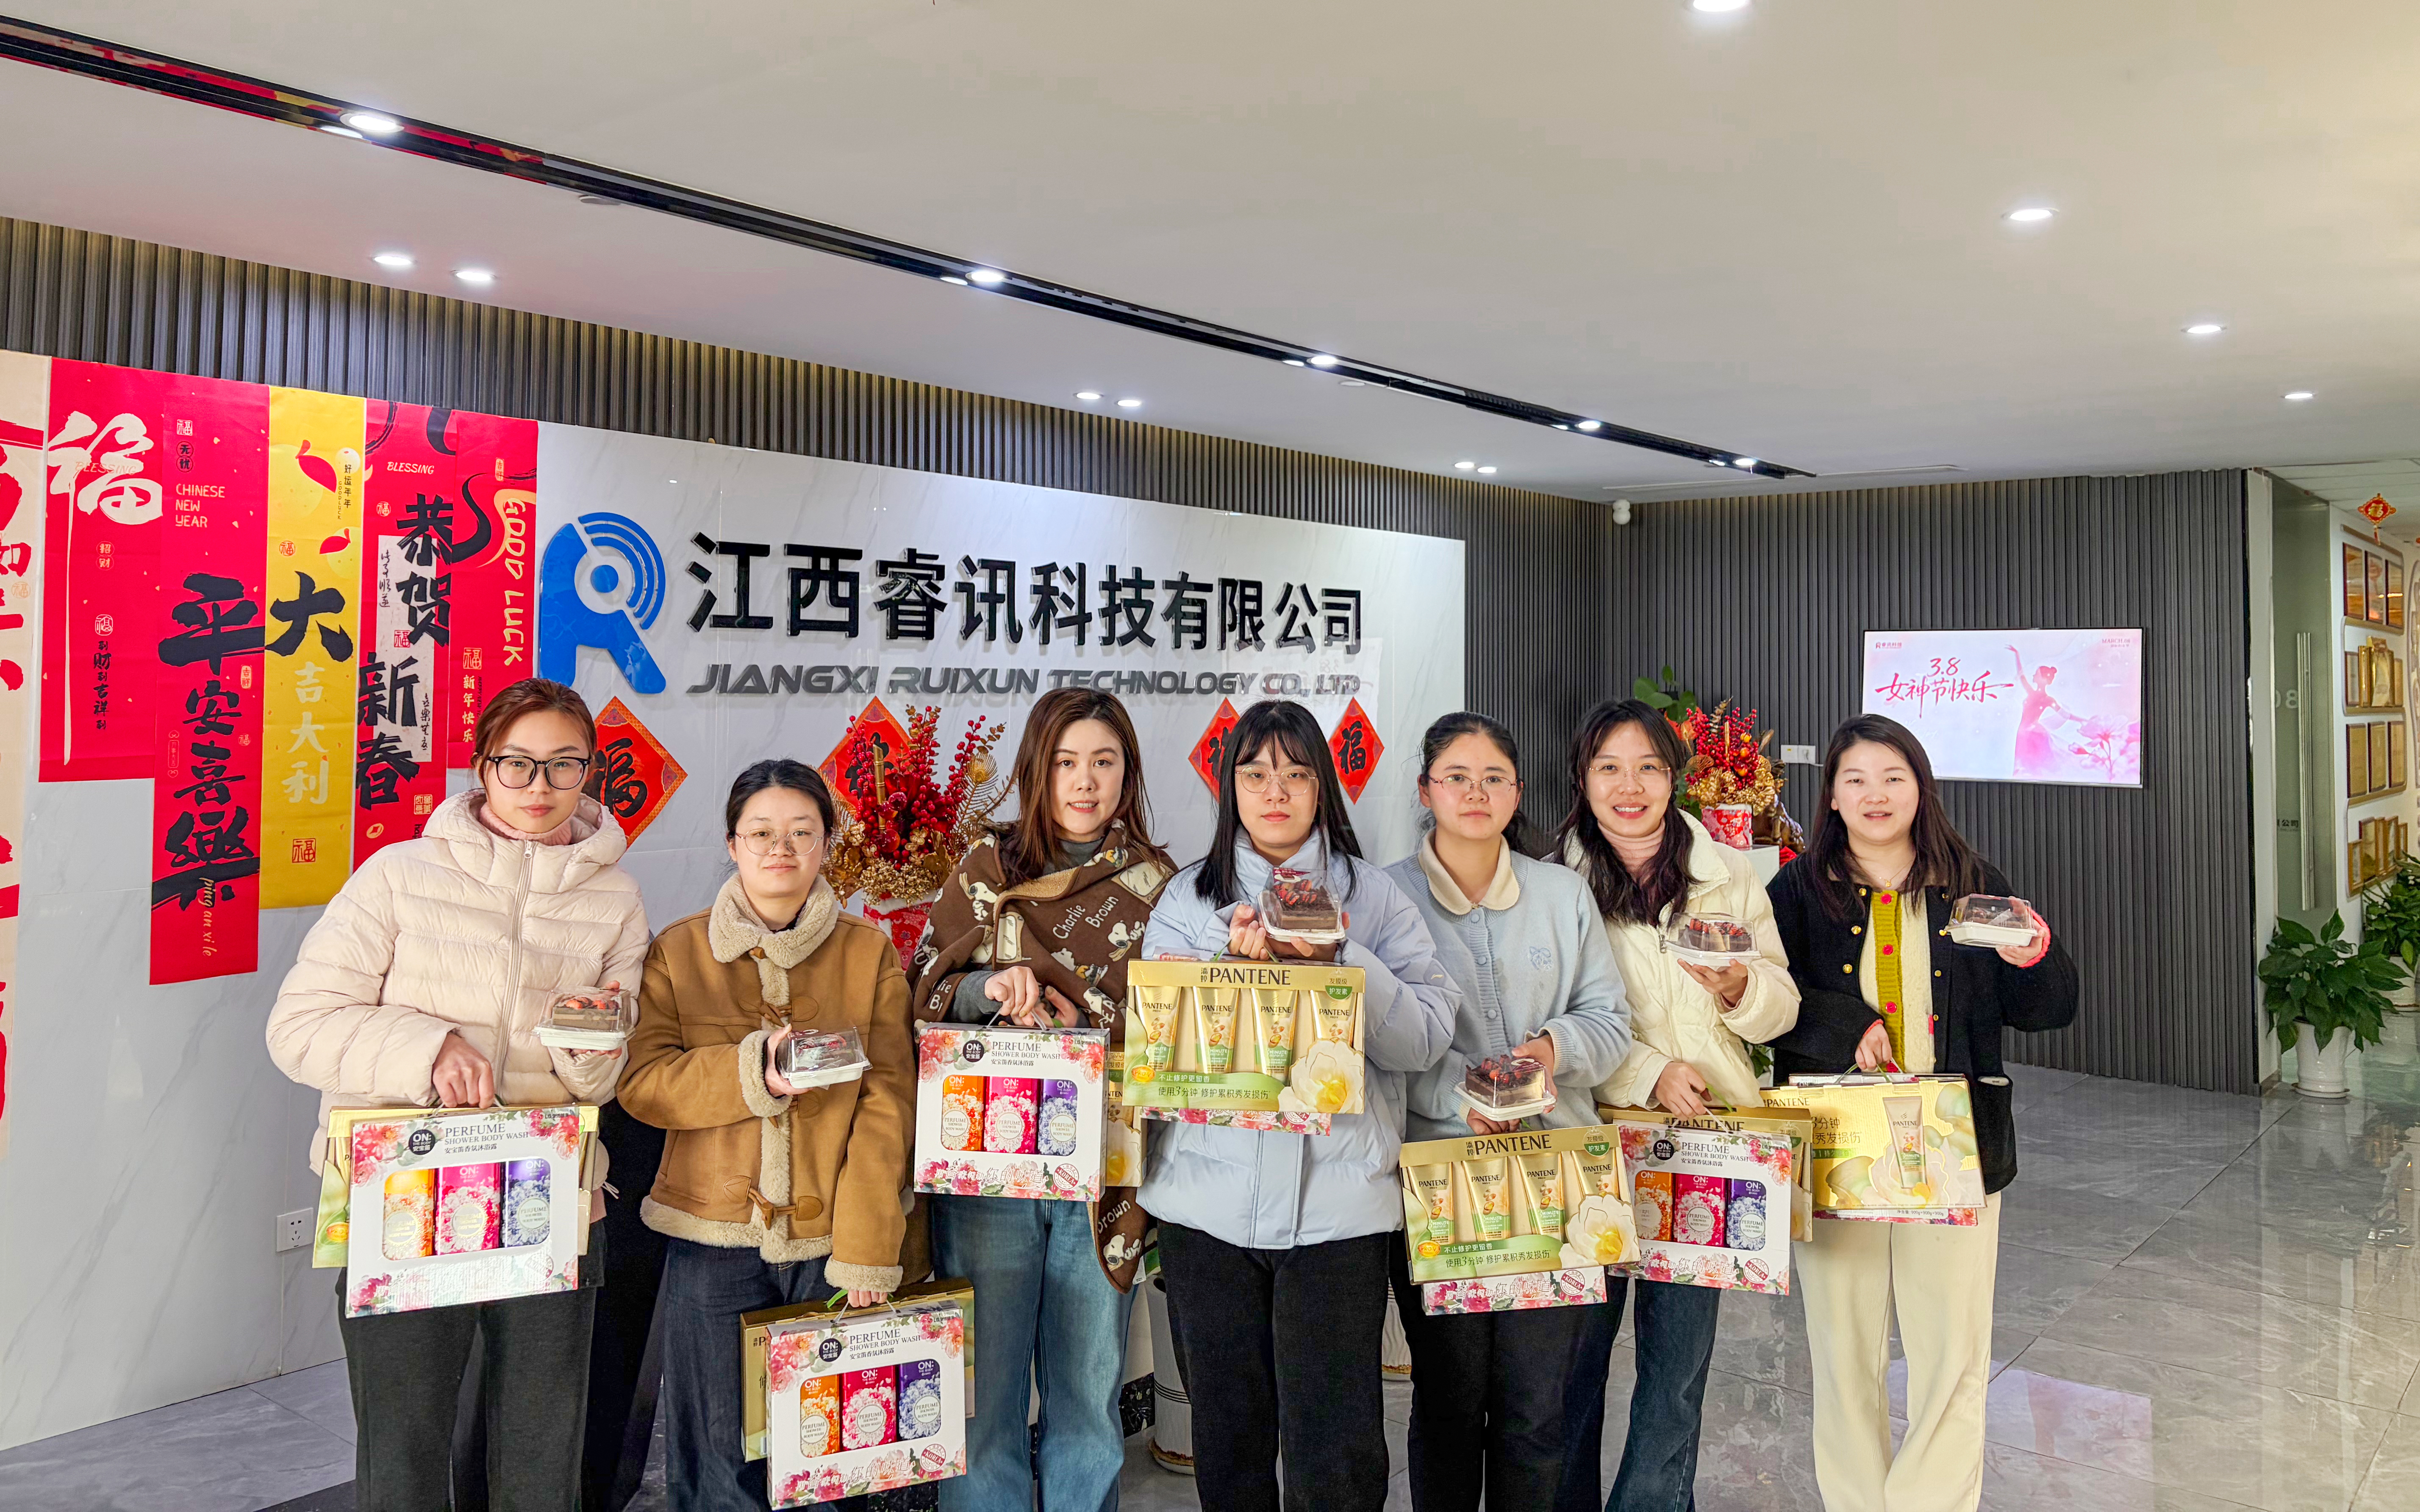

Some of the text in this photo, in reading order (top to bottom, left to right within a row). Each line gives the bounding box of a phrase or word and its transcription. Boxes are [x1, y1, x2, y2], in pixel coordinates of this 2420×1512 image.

[75, 461, 136, 476] BLESSING
[387, 461, 434, 475] BLESSING
[176, 484, 225, 498] CHINESE
[344, 464, 352, 508] 好运年年
[175, 500, 200, 512] NEW
[175, 515, 208, 528] YEAR
[99, 543, 111, 569] 招财
[504, 498, 526, 666] GOOD LUCK
[685, 532, 1361, 655] 江西睿讯科技有限公司
[356, 493, 453, 809] 恭贺新春
[463, 648, 482, 670] 福
[1927, 657, 1961, 677] 3.8
[686, 664, 879, 695] JIANGXI
[888, 667, 1040, 695] RUIXUN
[1047, 669, 1255, 695] TECHNOLOGY
[1315, 674, 1361, 695] LTD
[1875, 670, 2014, 719] 女神节快乐
[462, 675, 475, 742] 新年快乐
[1337, 720, 1366, 775] 福
[292, 838, 316, 863] 福
[200, 877, 218, 957] ping an xi le
[1085, 896, 1119, 928] Brown
[1052, 904, 1086, 939] Charlie
[1210, 967, 1291, 985] PANTENE
[1329, 987, 1348, 995] 护发素
[992, 1041, 1041, 1052] PERFUME
[1159, 1074, 1210, 1083] 不止修护更留香
[1767, 1097, 1810, 1107] PANTENE
[445, 1123, 505, 1137] PERFUME
[413, 1133, 432, 1142] ON:
[445, 1136, 479, 1145] SHOWER
[481, 1134, 503, 1142] BODY
[1474, 1134, 1552, 1155] PANTENE
[1682, 1142, 1729, 1154] PERFUME
[1527, 1169, 1556, 1177] PANTENE
[1583, 1164, 1612, 1172] PANTENE
[1059, 1169, 1074, 1185] KOREA
[1418, 1179, 1448, 1187] PANTENE
[1746, 1181, 1761, 1189] ON:
[1444, 1243, 1493, 1254] 不止修护更留香
[1748, 1263, 1764, 1278] KOREA
[1564, 1276, 1581, 1289] KOREA
[850, 1329, 901, 1344] PERFUME
[822, 1341, 838, 1350] ON:
[849, 1343, 880, 1351] SHOWER
[918, 1360, 934, 1370] ON:
[861, 1369, 878, 1379] ON:
[805, 1379, 821, 1389] ON:
[802, 1422, 826, 1430] PERFUME
[924, 1451, 941, 1464] KOREA
